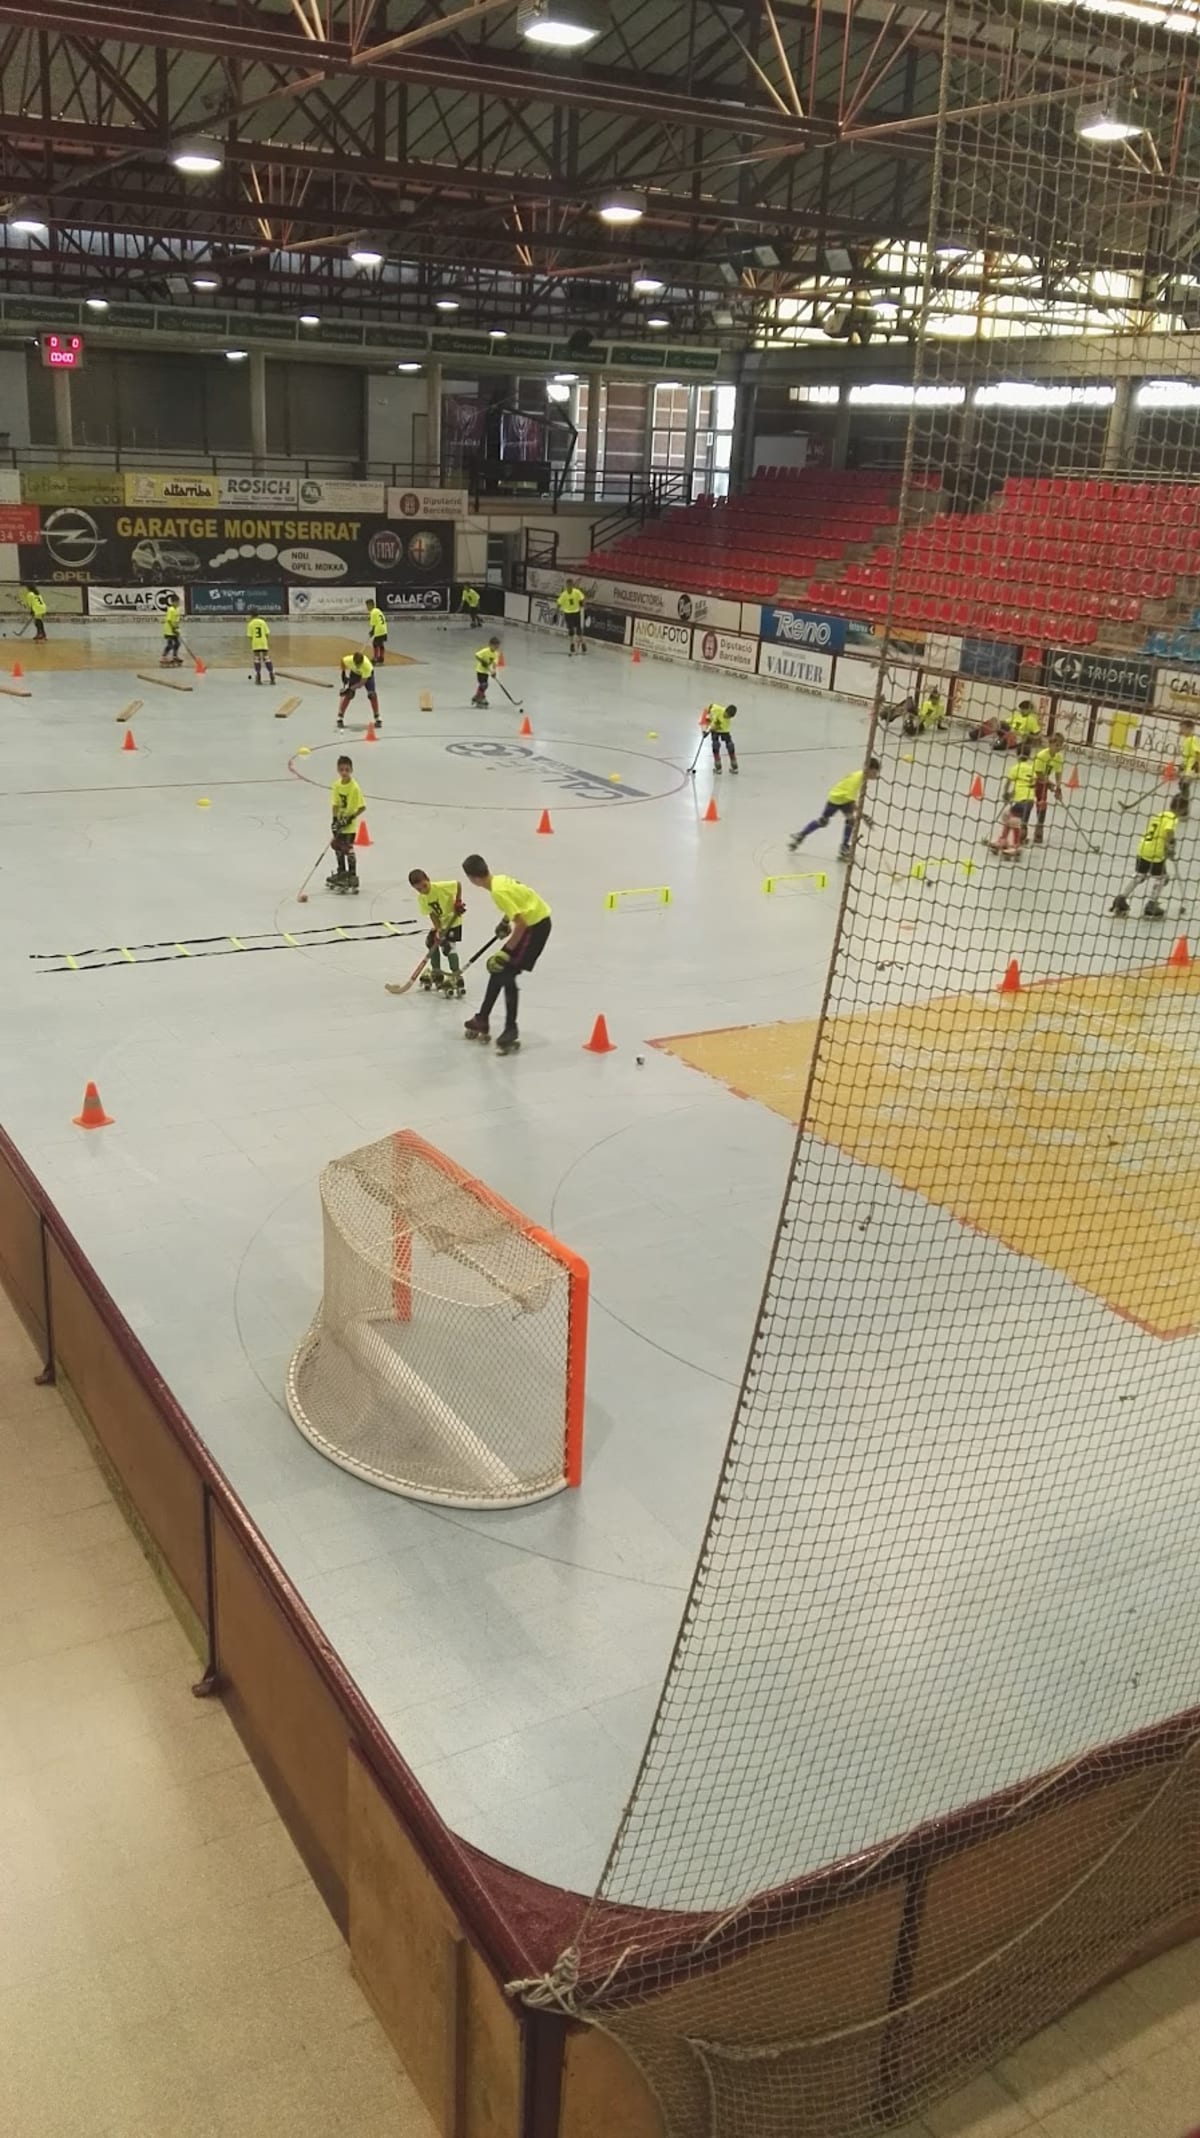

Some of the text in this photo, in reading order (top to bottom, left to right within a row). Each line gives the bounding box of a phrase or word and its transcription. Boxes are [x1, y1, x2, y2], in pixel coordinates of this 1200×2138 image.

[163, 483, 212, 497] altarriba
[228, 479, 290, 495] ROSICH
[116, 517, 361, 541] GARATGE MONTSERRAT
[291, 551, 309, 560] NOU
[375, 542, 396, 559] FIAT
[291, 562, 312, 571] OPEL
[52, 570, 93, 582] OPEL
[103, 593, 153, 606] CALAF
[386, 593, 422, 605] CALAF
[772, 610, 832, 646] Reno
[767, 655, 823, 683] VALLTER
[1088, 665, 1149, 689] TRIOPTIC
